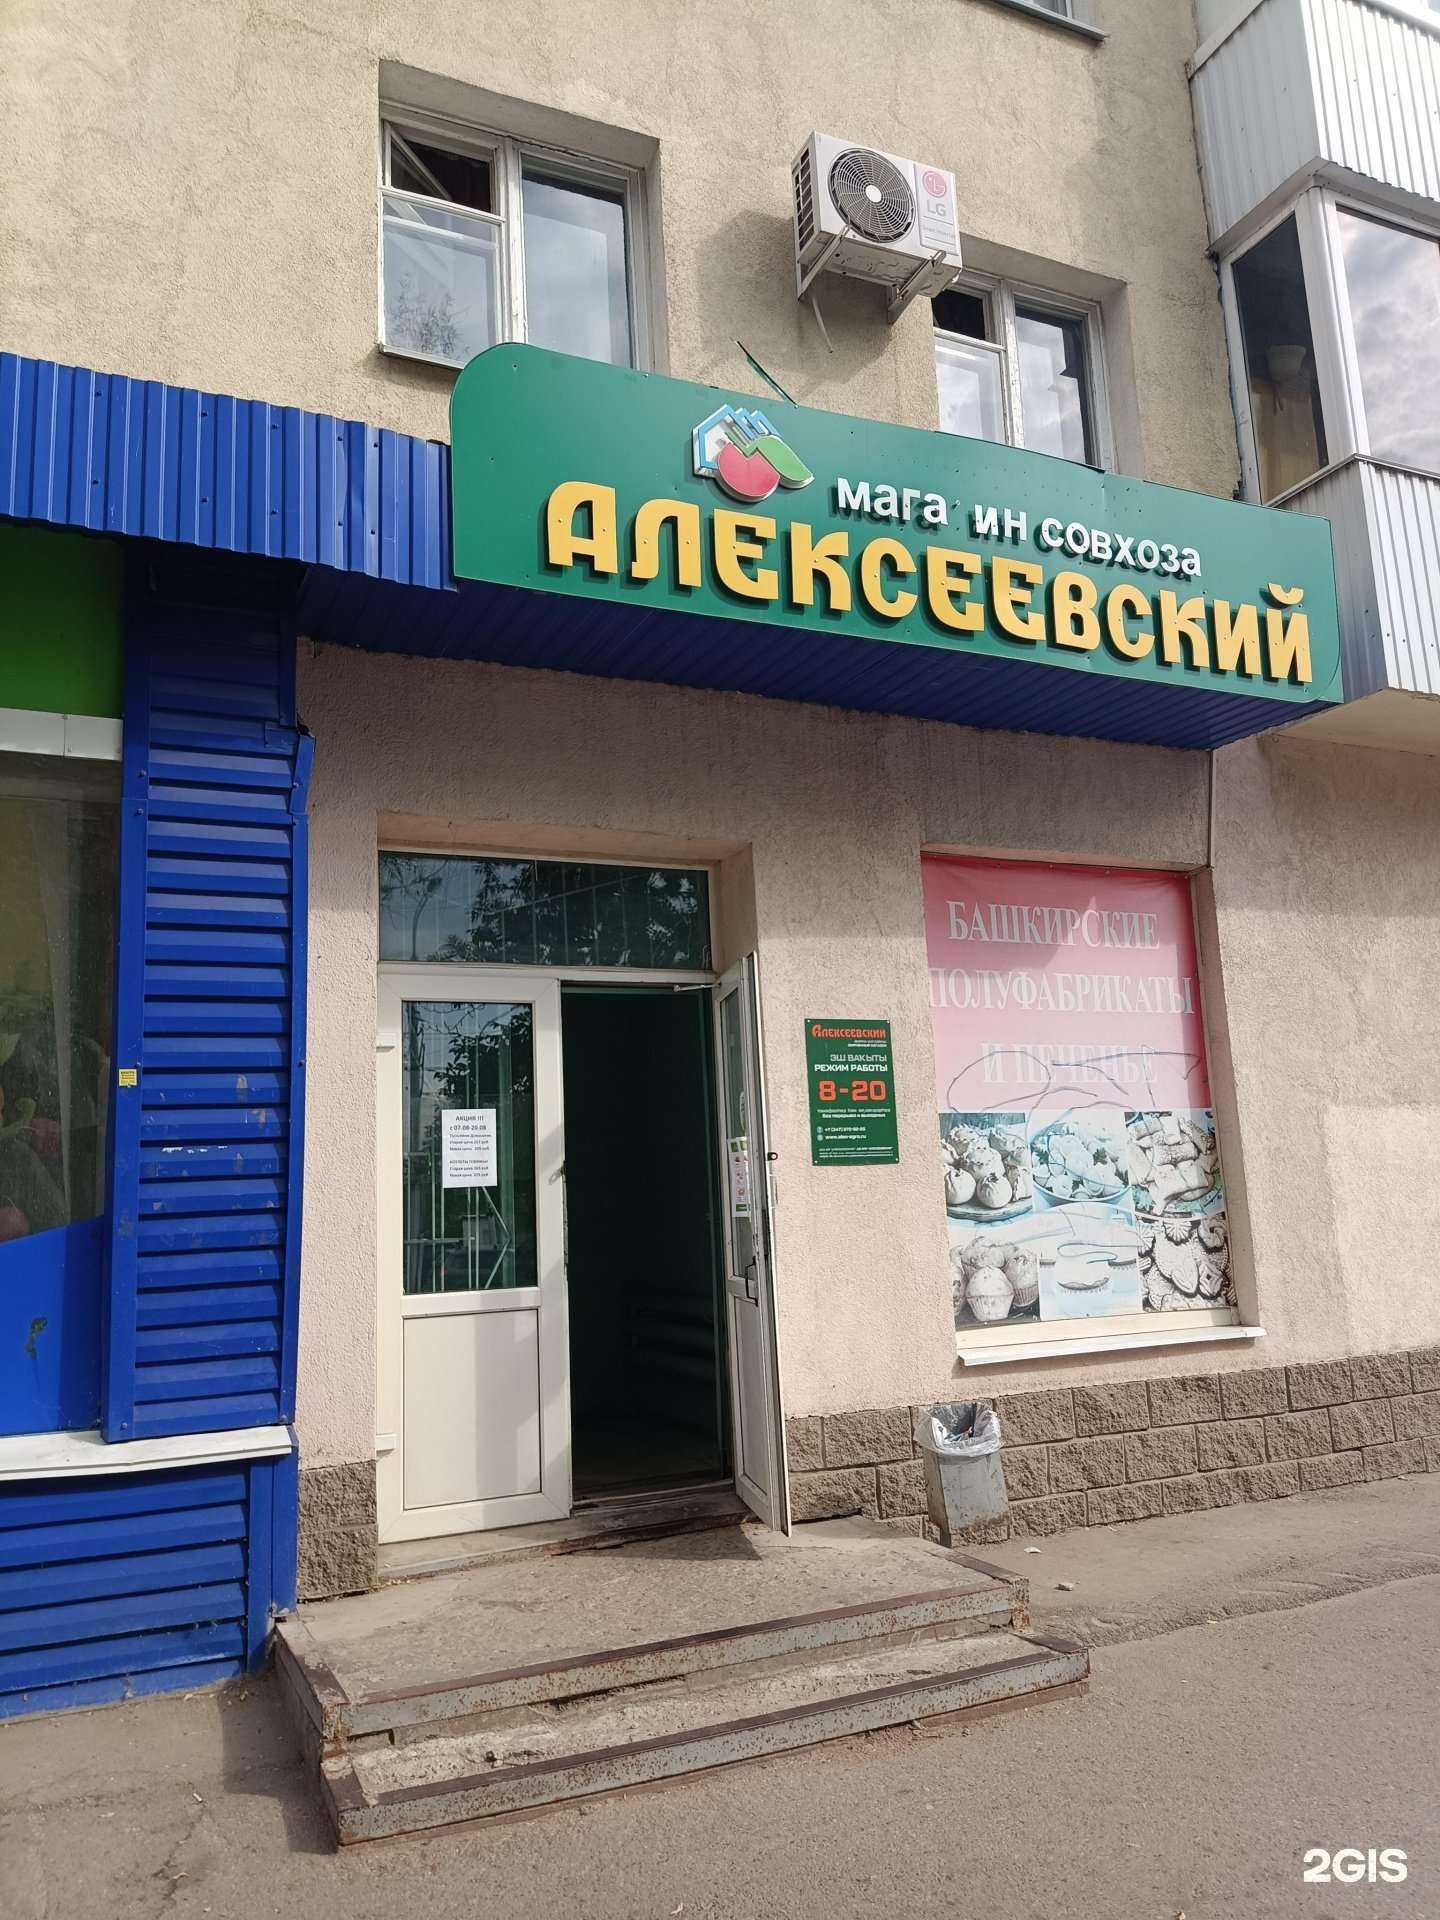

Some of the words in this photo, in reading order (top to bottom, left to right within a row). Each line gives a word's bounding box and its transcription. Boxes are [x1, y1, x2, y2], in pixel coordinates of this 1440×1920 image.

[927, 199, 947, 217] LG
[1041, 517, 1203, 577] совхоза
[546, 481, 1313, 684] АЛЕКСЕЕВСКИЙ
[946, 900, 1160, 950] БАШКИРСКИЕ
[929, 967, 1195, 1014] ПОЛУФАБРИКАТЫ
[814, 1064, 849, 1072] РЕЖИМ
[850, 1063, 888, 1072] РАБОТЫ
[979, 1043, 1009, 1083] И
[1013, 1043, 1160, 1084] ПЕЧЕНЬЕ
